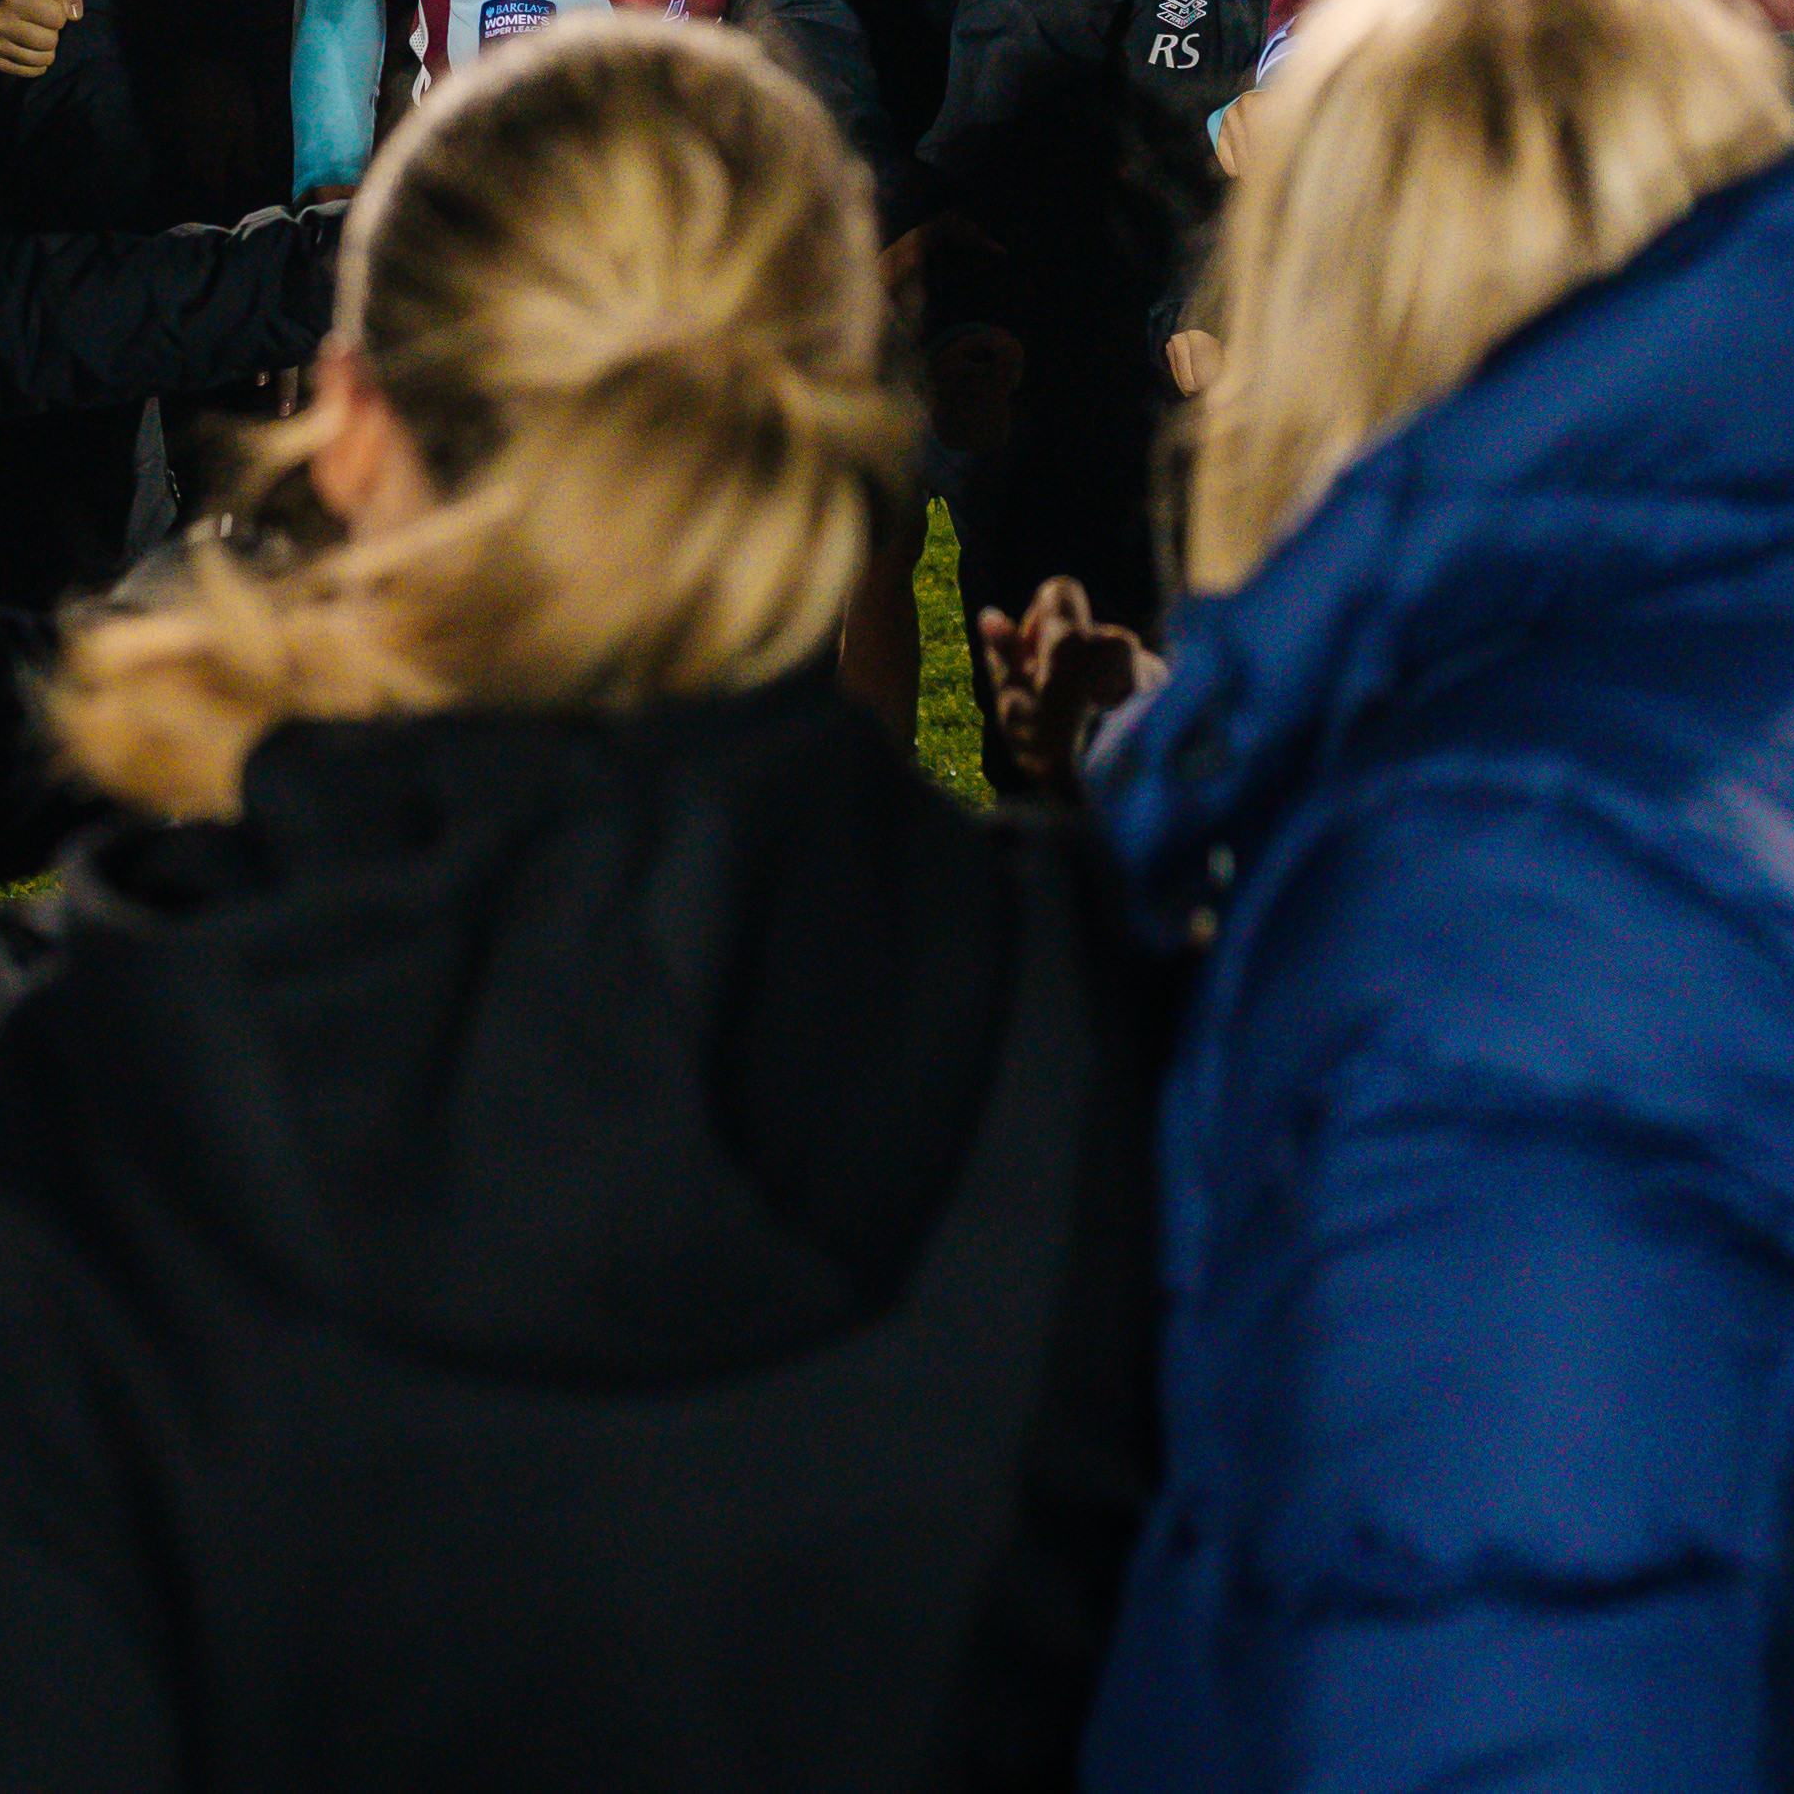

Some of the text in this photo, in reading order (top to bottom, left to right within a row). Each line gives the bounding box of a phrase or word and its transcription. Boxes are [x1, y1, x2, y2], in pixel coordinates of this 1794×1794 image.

[496, 2, 550, 15] BARCLAYS
[485, 14, 551, 30] WOMEN'S
[484, 25, 549, 39] SUPER LEAG
[1148, 33, 1201, 70] RS
